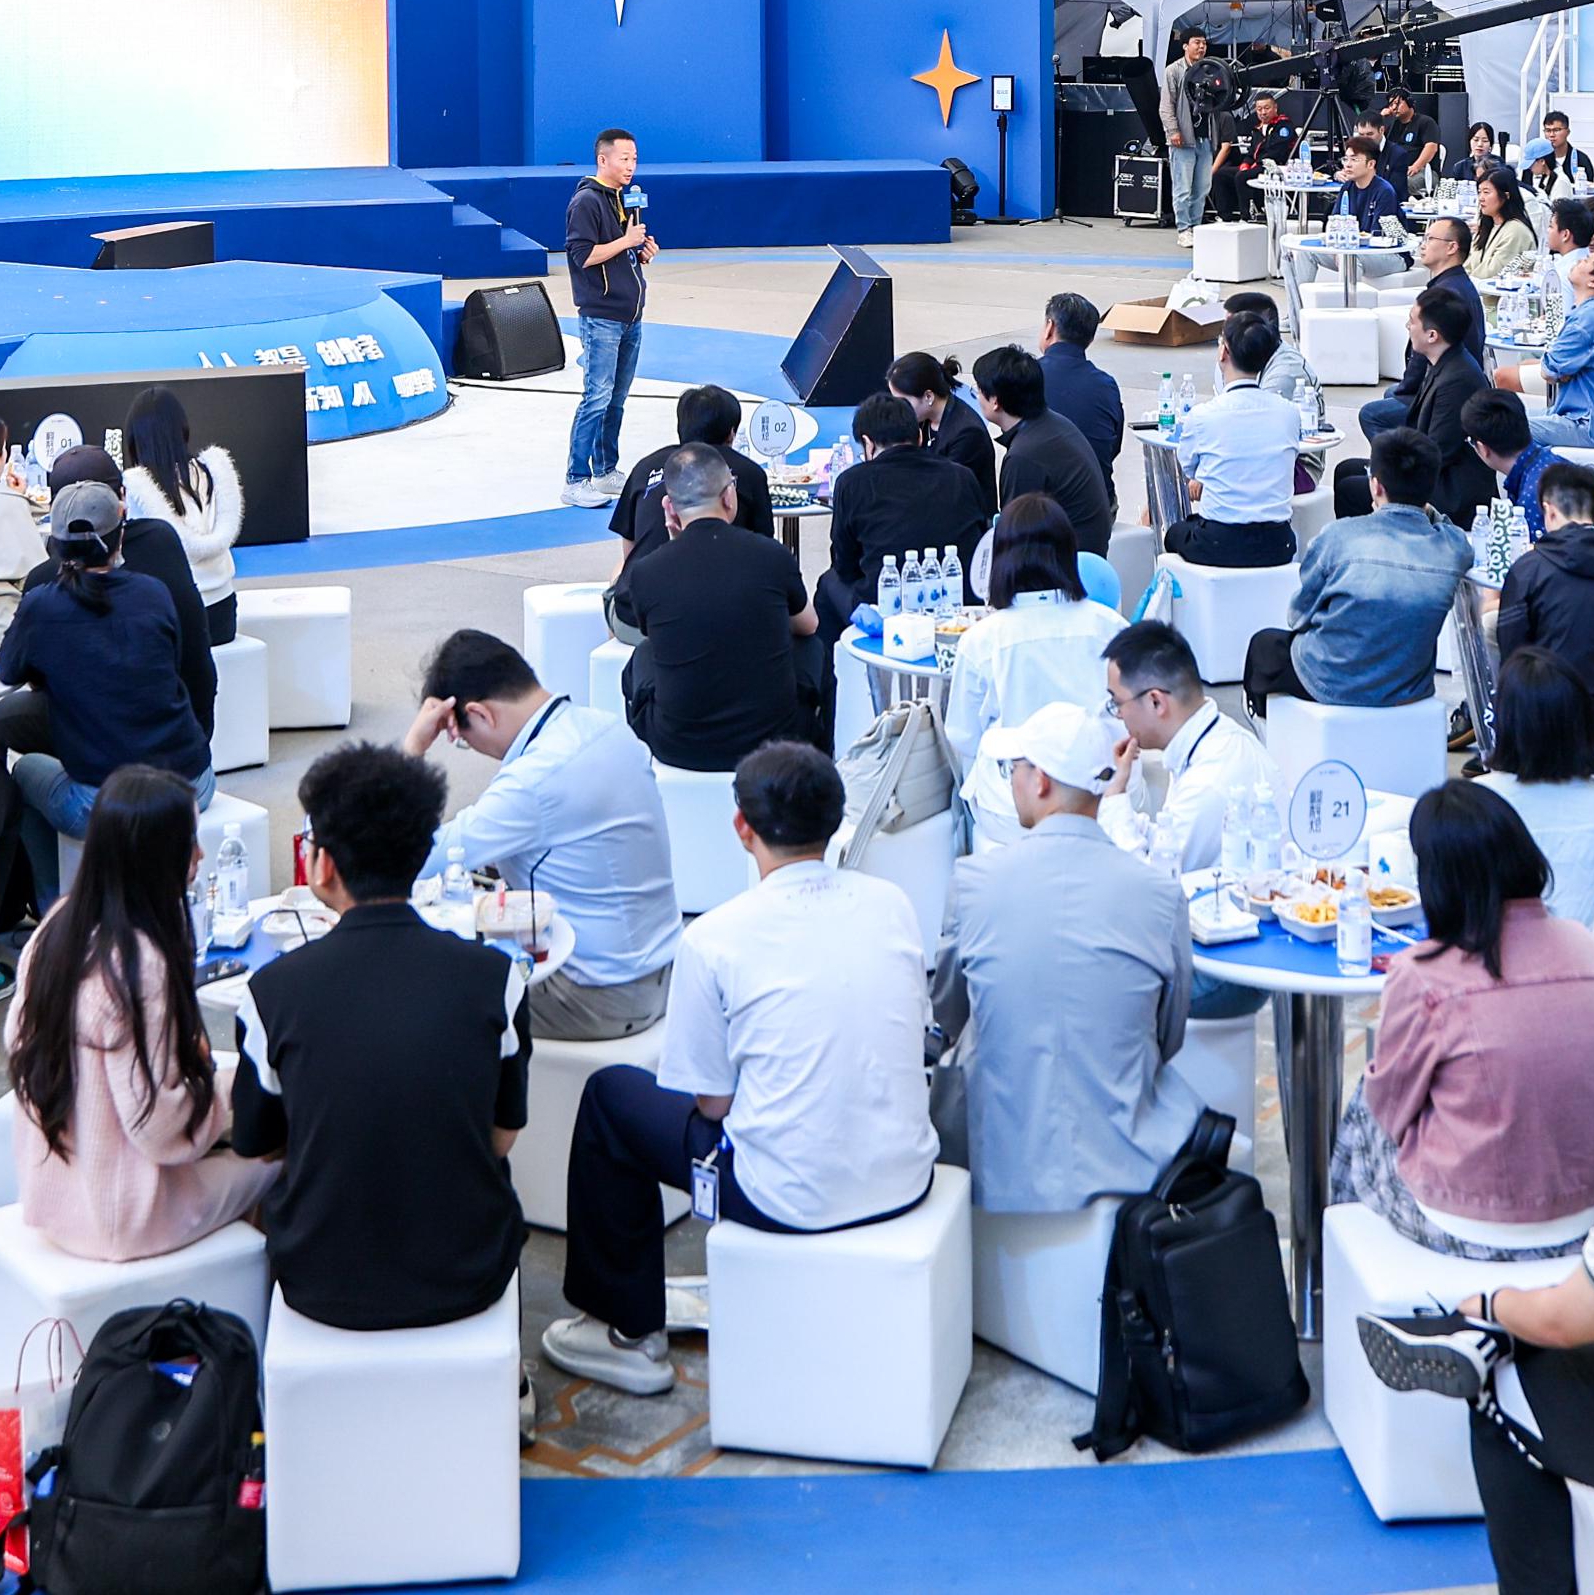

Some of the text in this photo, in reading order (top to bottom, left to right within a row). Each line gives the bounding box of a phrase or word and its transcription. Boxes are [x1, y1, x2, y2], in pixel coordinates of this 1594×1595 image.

[774, 422, 787, 433] 02
[60, 438, 73, 448] 01
[1332, 800, 1350, 818] 21
